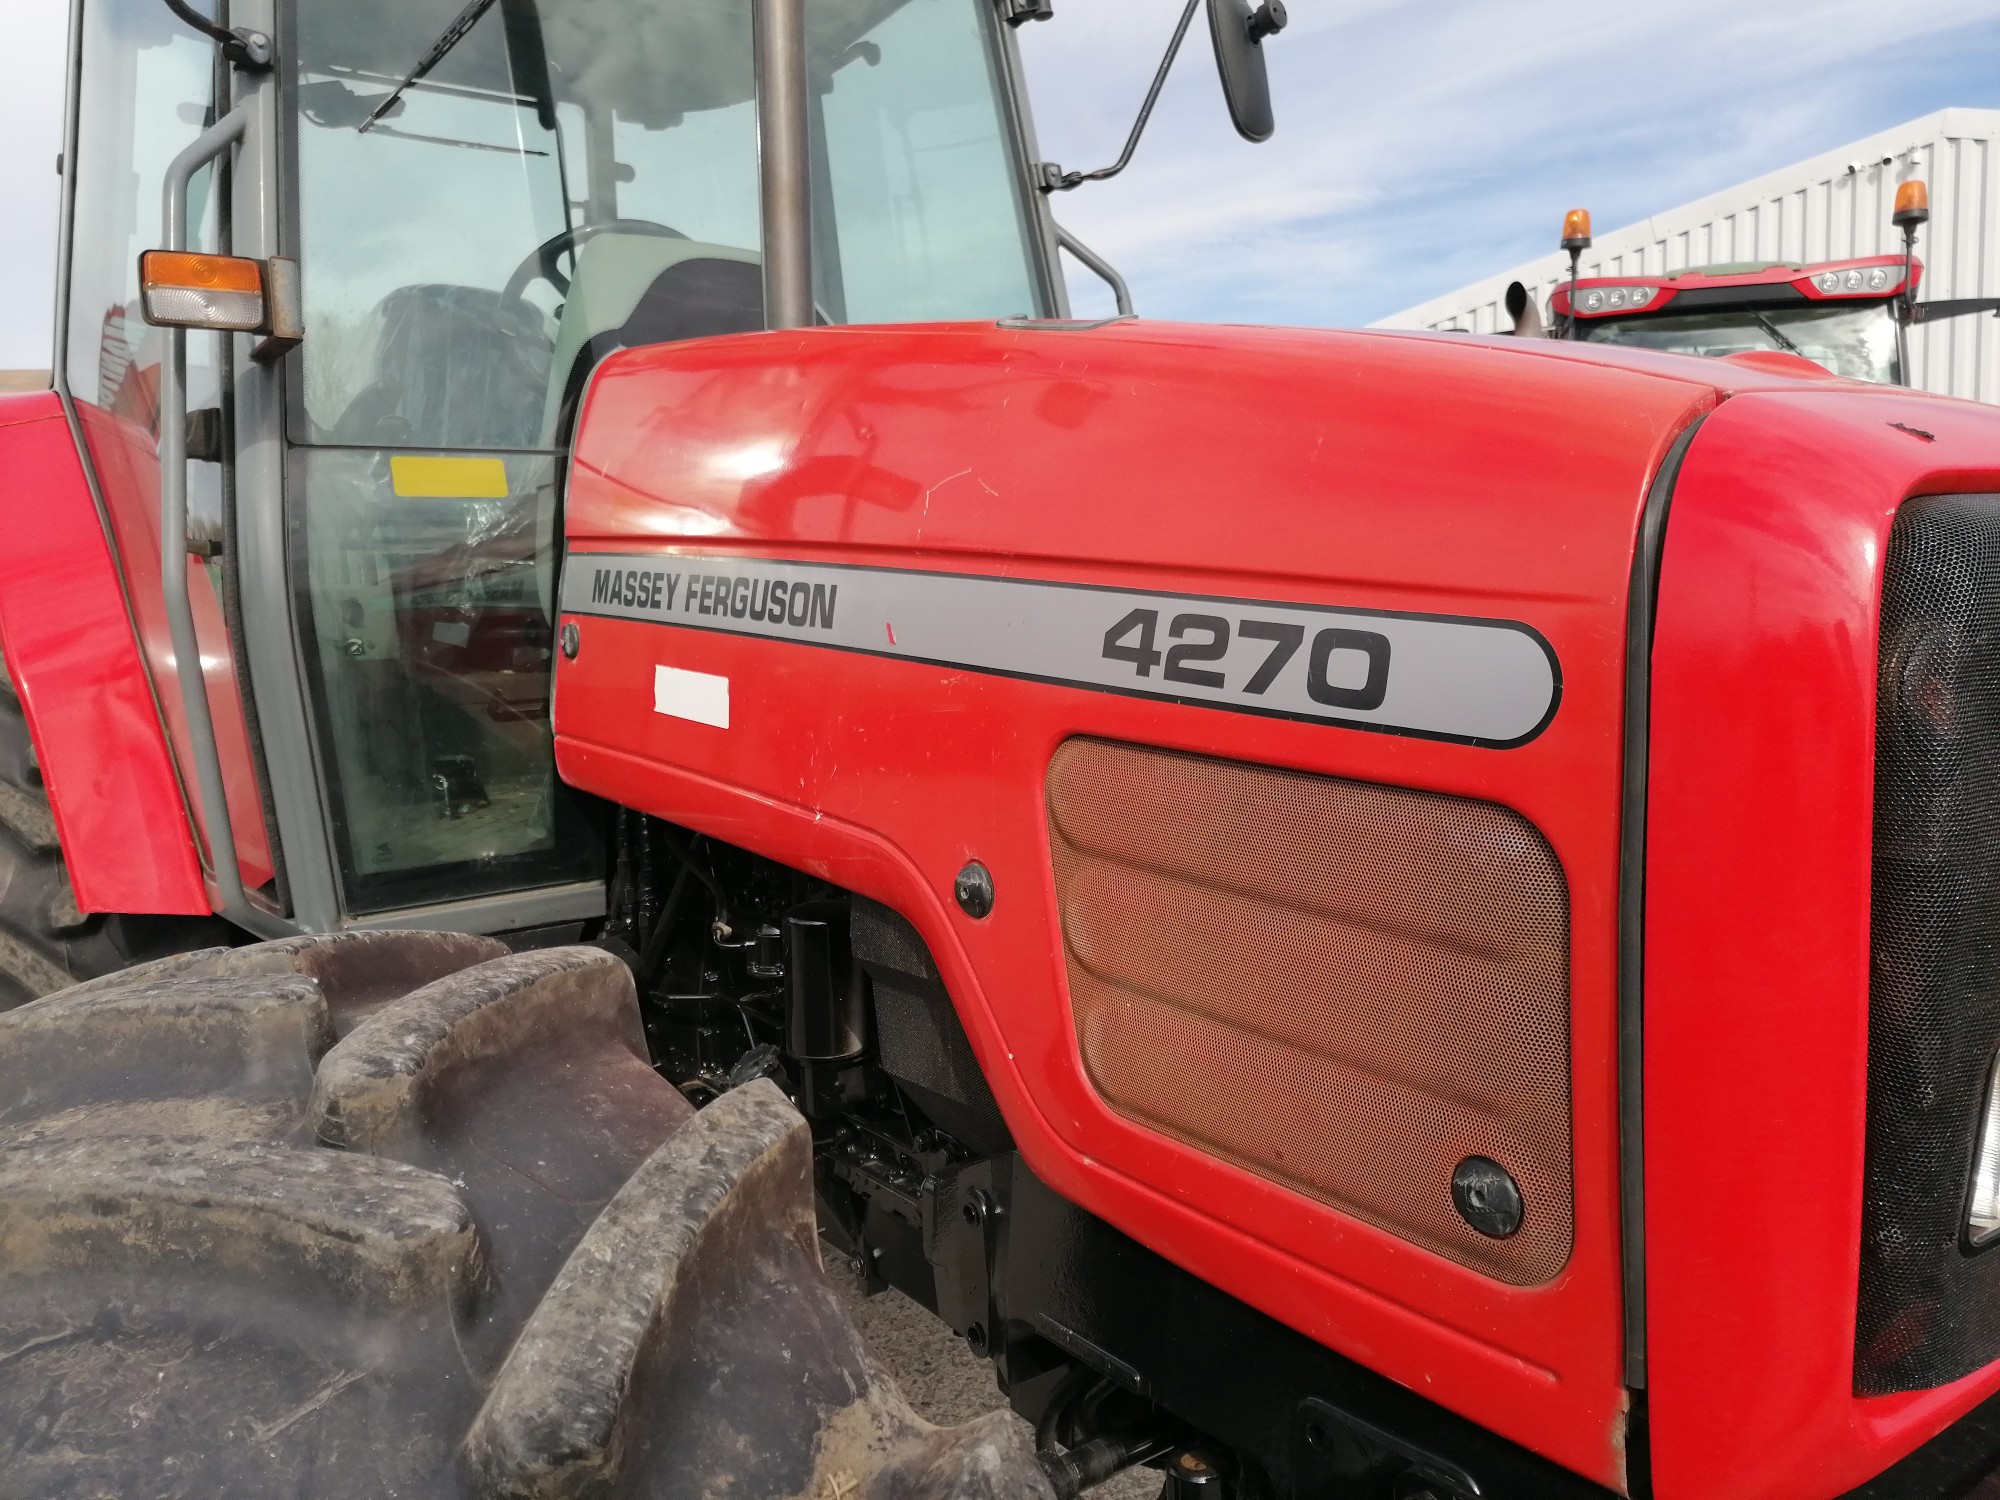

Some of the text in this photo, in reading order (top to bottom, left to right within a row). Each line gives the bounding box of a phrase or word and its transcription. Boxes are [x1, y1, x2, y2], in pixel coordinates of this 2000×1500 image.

[592, 569, 838, 630] MASSEY FERGUSON
[1102, 608, 1391, 711] 4270
